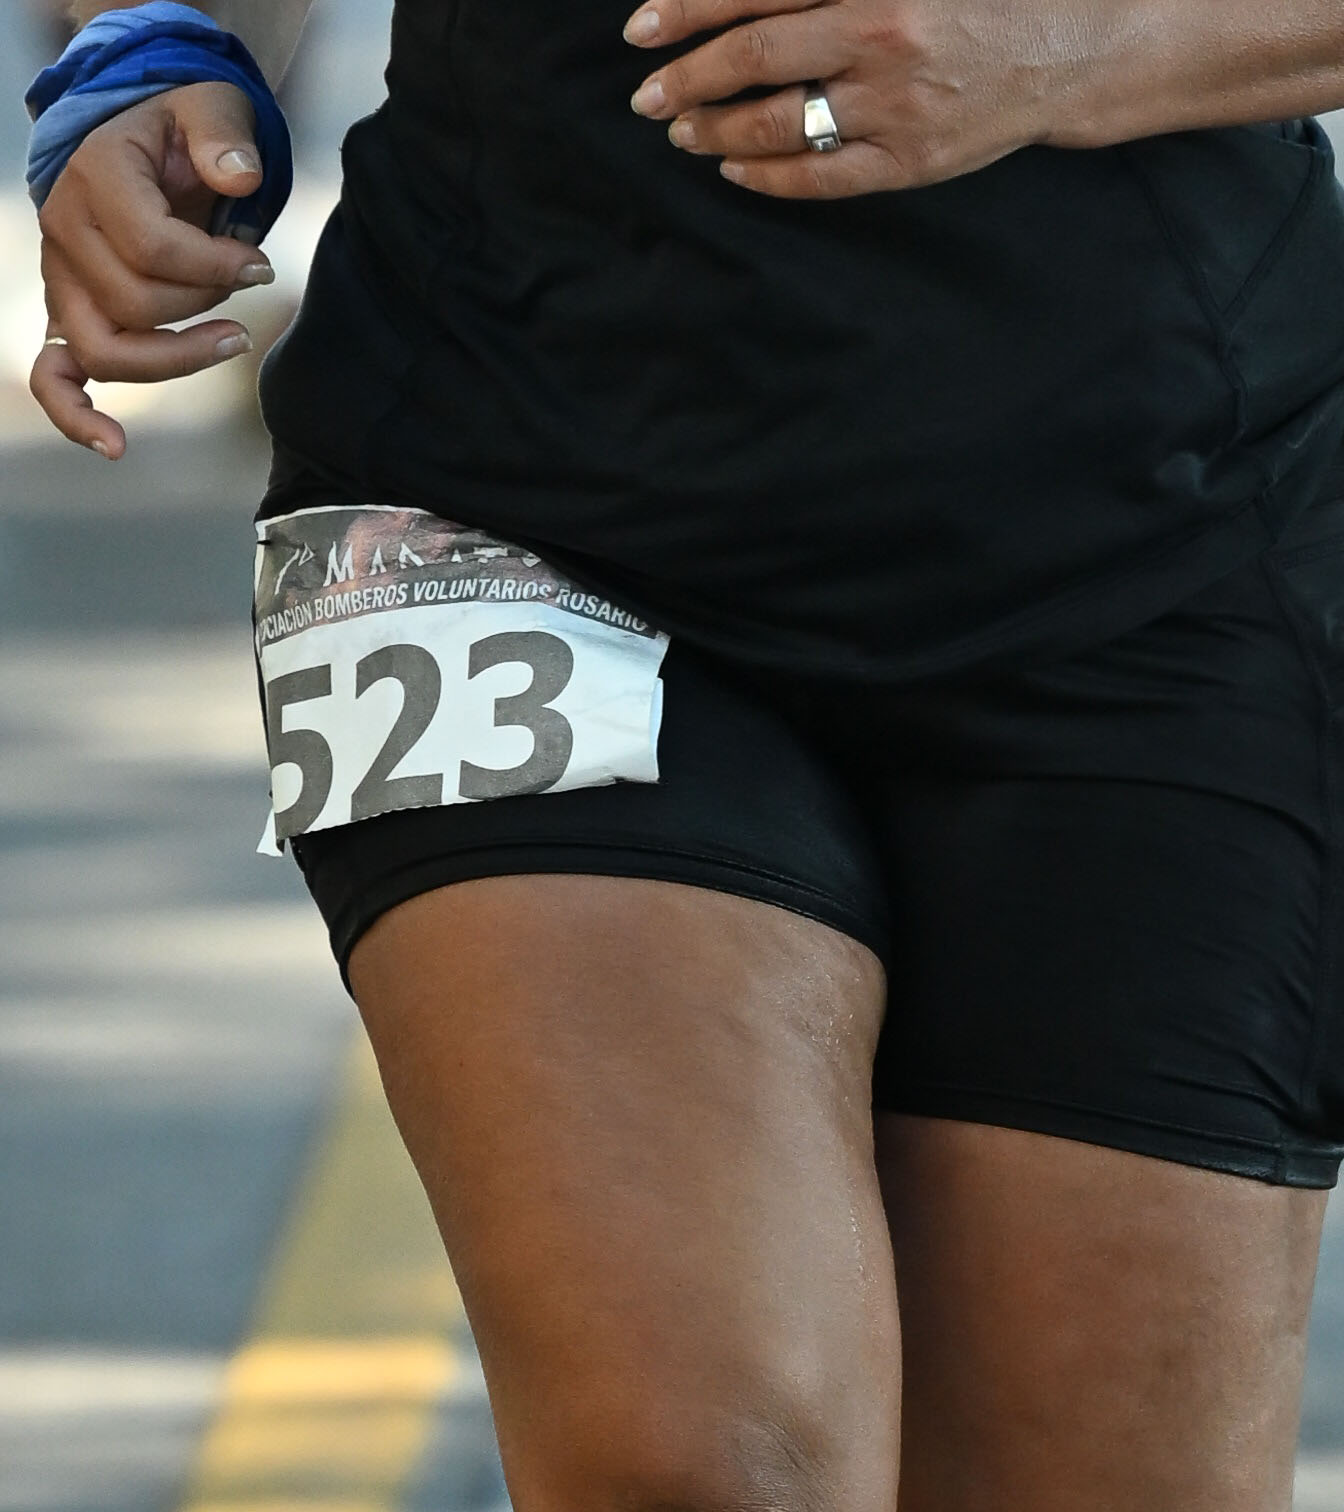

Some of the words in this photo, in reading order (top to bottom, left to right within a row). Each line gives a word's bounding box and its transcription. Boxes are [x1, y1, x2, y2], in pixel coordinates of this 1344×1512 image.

[314, 582, 408, 621] BOMBEROS
[413, 578, 552, 602] VOLUNTARIOS
[555, 587, 649, 632] ROSARIO
[266, 630, 575, 840] 523
